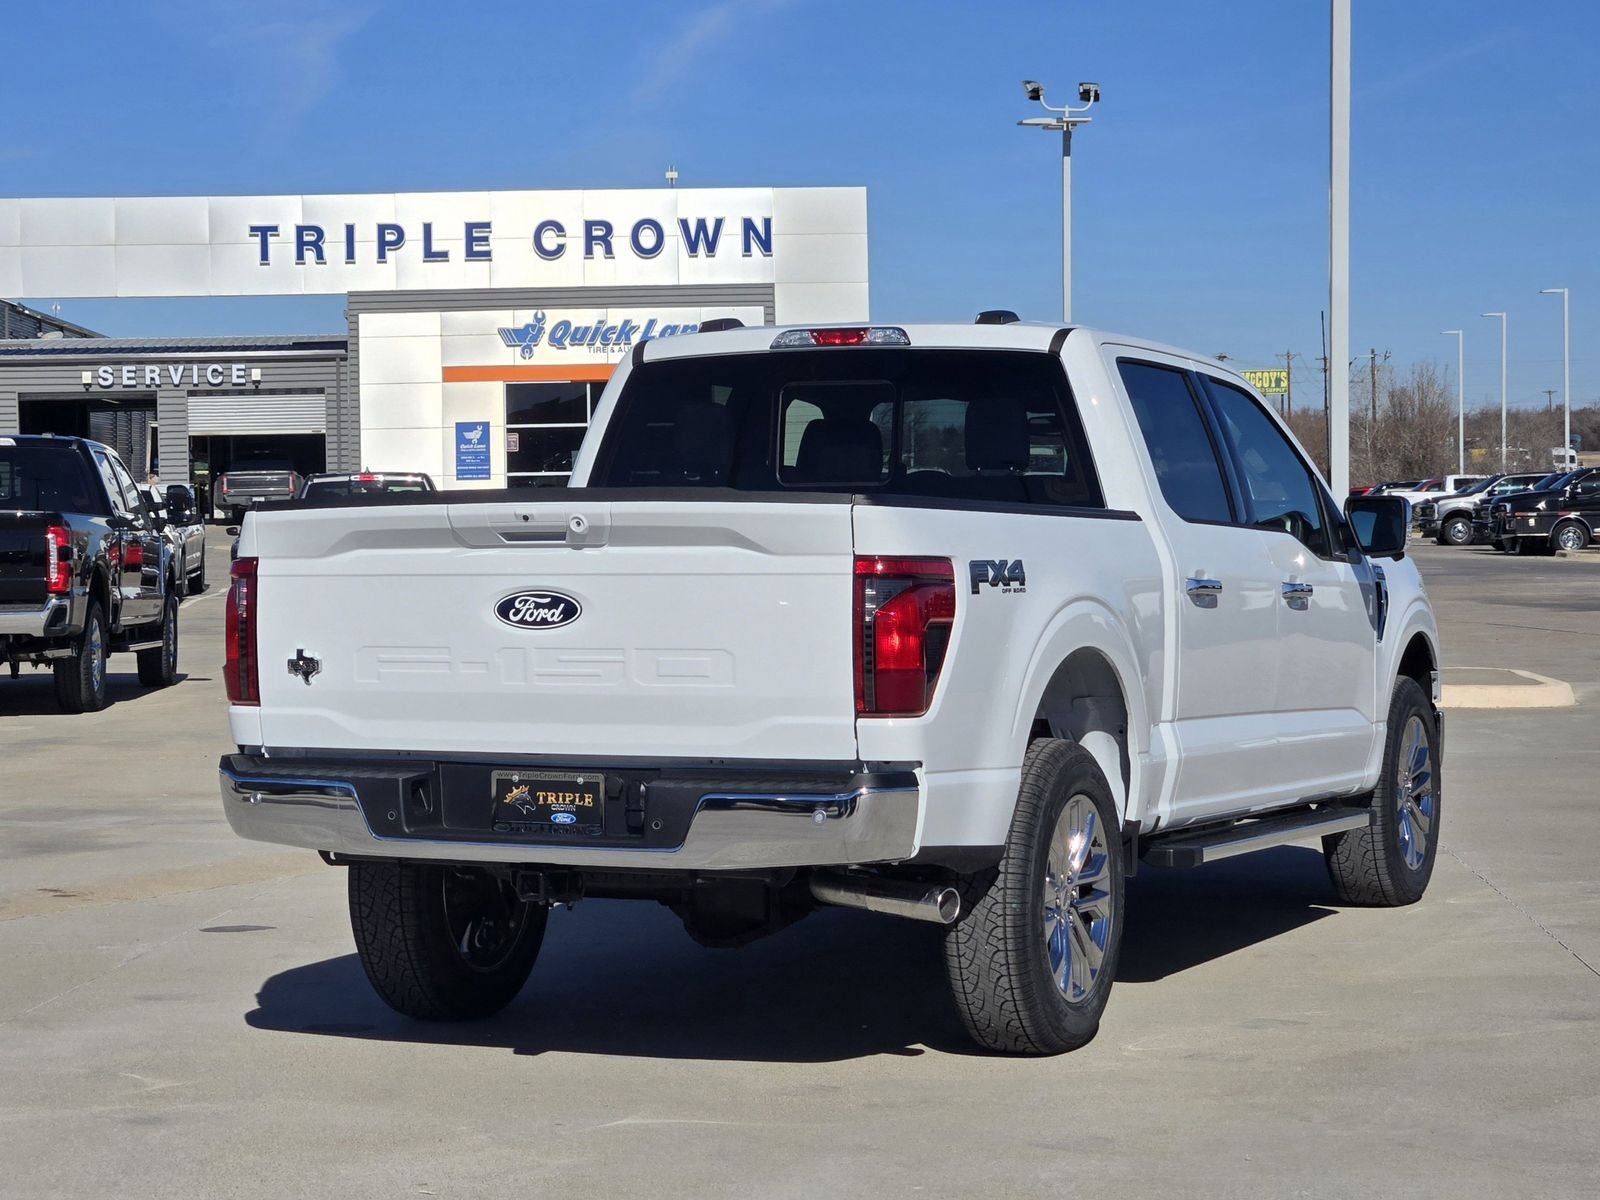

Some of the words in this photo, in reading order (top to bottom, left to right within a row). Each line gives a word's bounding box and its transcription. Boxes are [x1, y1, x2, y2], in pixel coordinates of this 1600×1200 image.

[249, 220, 492, 266] TRIPLE
[532, 215, 774, 261] CROWN
[548, 318, 641, 350] Quick
[641, 318, 701, 341] Lan
[587, 346, 607, 354] TIRE
[609, 346, 616, 354] &
[97, 363, 247, 388] SERVICE
[969, 559, 1026, 595] FX4
[508, 595, 566, 624] Ford
[354, 645, 737, 689] F-150
[496, 770, 600, 782] wwwTripleCrownFordcom
[536, 791, 593, 808] TRIPLE
[550, 804, 576, 812] CROWN
